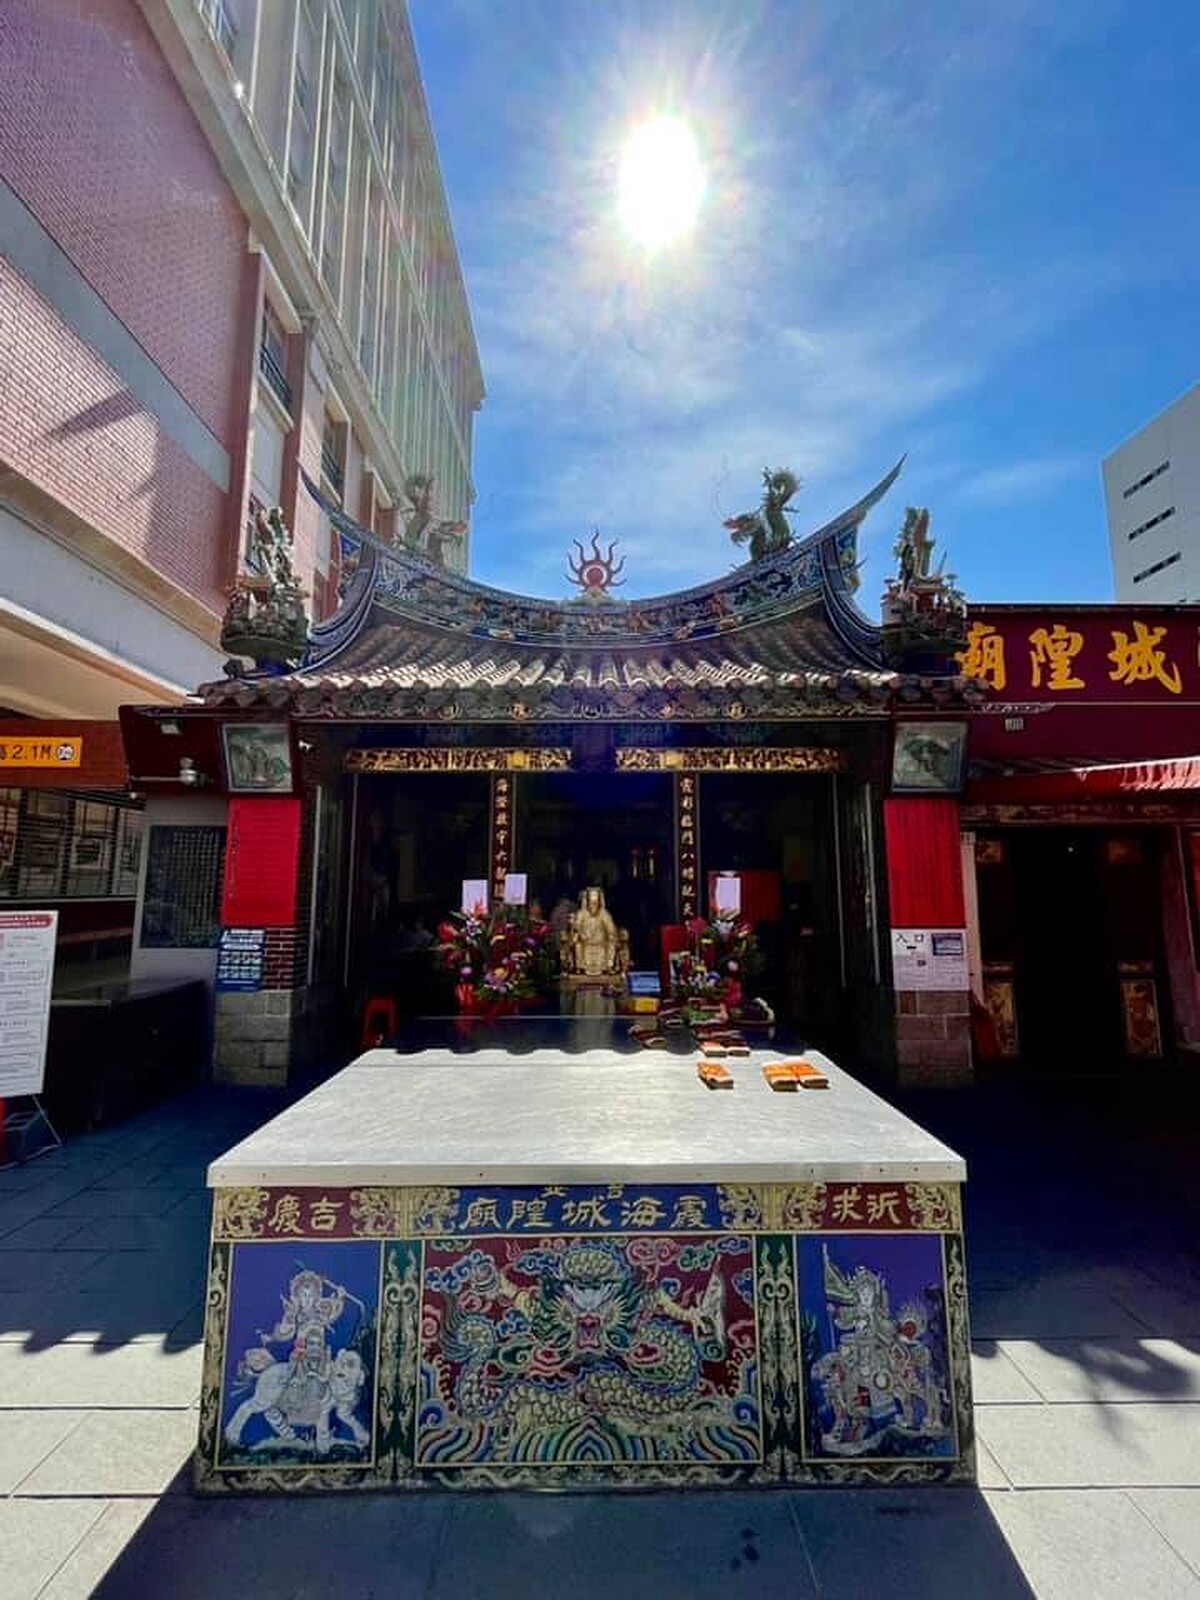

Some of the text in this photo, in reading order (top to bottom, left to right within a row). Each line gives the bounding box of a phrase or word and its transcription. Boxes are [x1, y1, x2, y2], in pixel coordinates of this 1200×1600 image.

[955, 620, 1200, 694] 城隍廟
[896, 933, 925, 944] 入口
[459, 1195, 719, 1230] 霞海城隍廟
